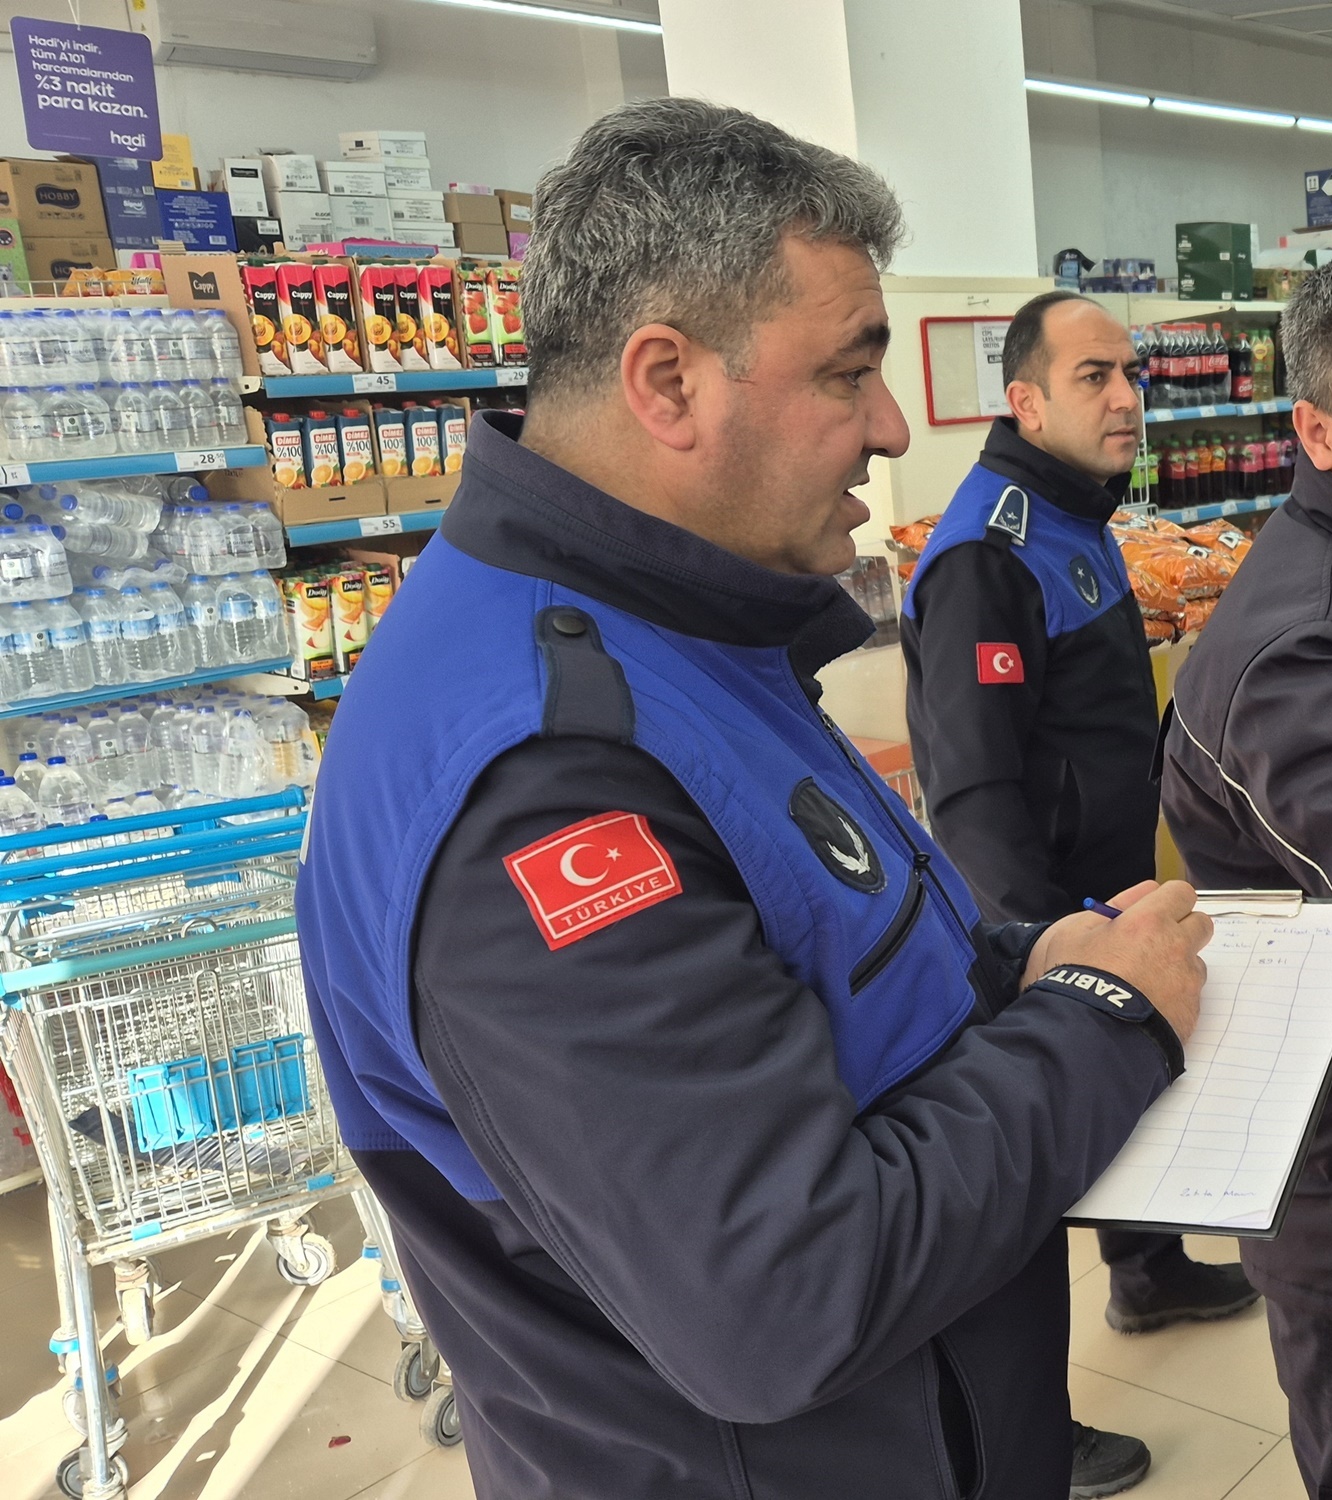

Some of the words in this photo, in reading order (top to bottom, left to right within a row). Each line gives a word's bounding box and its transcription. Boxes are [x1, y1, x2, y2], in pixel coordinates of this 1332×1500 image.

[28, 34, 71, 50] Hadi'yi
[31, 48, 56, 60] tüm
[59, 52, 86, 64] A101
[32, 61, 134, 82] harcamalarından
[34, 74, 62, 91] %3
[67, 80, 116, 98] nakit
[37, 94, 84, 111] para
[89, 97, 148, 118] kazan.
[110, 130, 146, 147] hadi
[40, 191, 76, 200] HOBBY
[193, 281, 215, 293] Cappy
[254, 291, 276, 300] Cappy
[291, 291, 312, 300] Cappy
[327, 291, 348, 300] Cappy
[375, 293, 394, 302] Cappy
[399, 291, 417, 299] Cappy
[433, 291, 451, 300] Cappy
[376, 376, 390, 385] 45
[513, 372, 524, 380] 29
[200, 454, 215, 464] 28
[382, 520, 396, 529] 55
[561, 875, 663, 928] TÜRKİYE
[1039, 969, 1133, 1009] ZABIT
